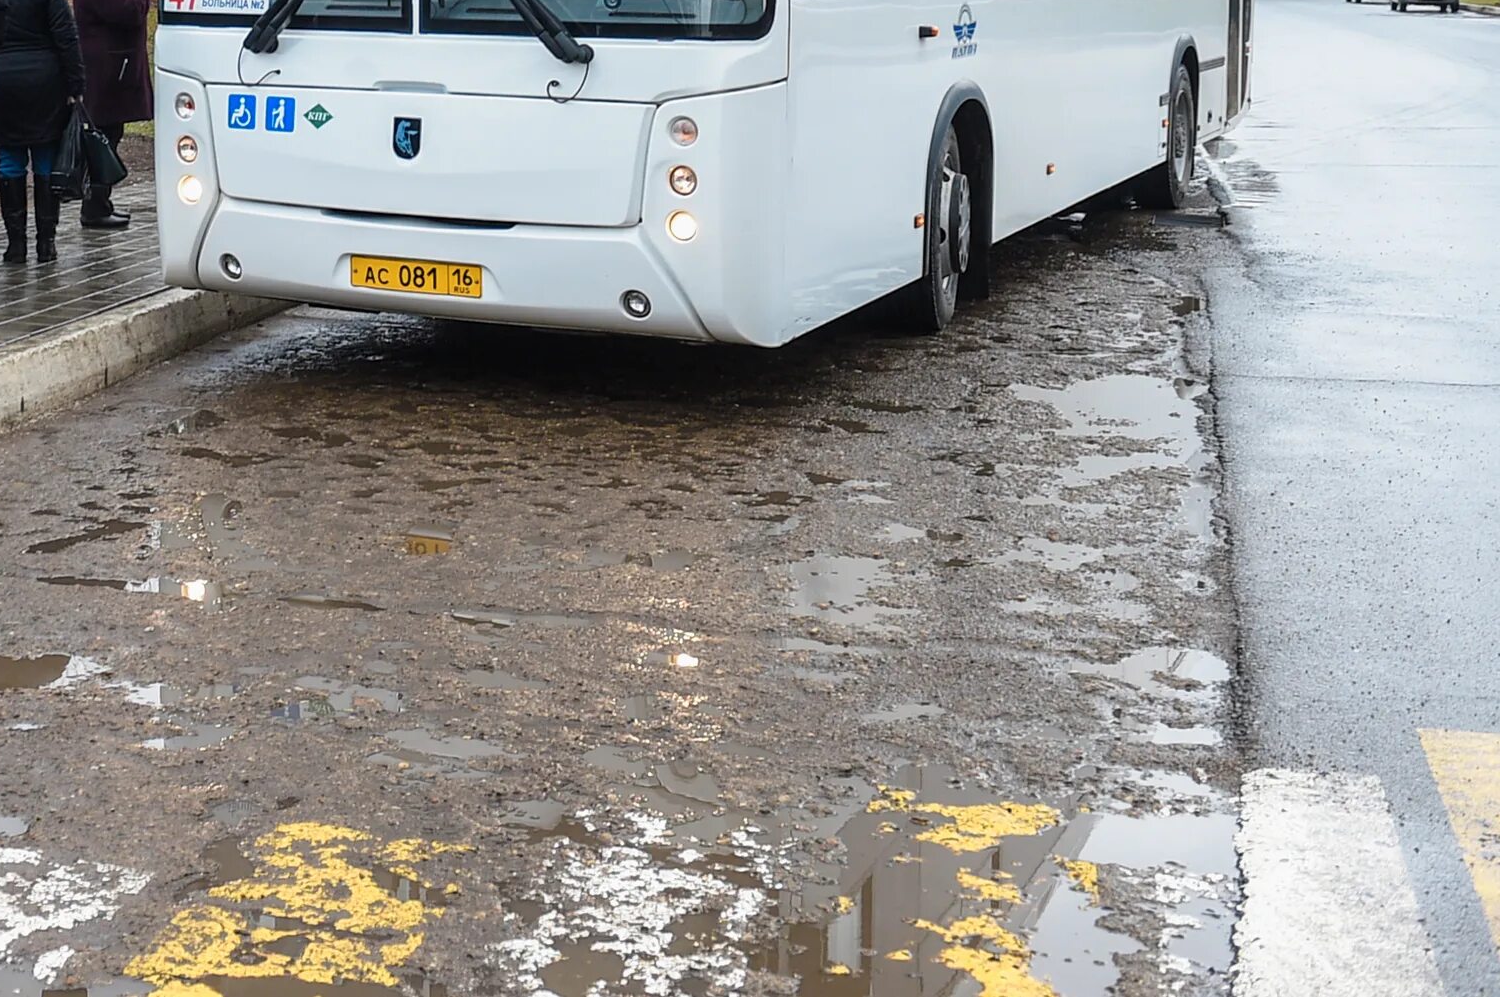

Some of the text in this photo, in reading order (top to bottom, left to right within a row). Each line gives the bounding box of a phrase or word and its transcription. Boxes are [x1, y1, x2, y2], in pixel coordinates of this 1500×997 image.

[250, 0, 265, 10] №2
[307, 111, 330, 122] КПГ
[399, 265, 438, 290] 081
[451, 268, 473, 286] 16
[453, 285, 470, 294] RUS
